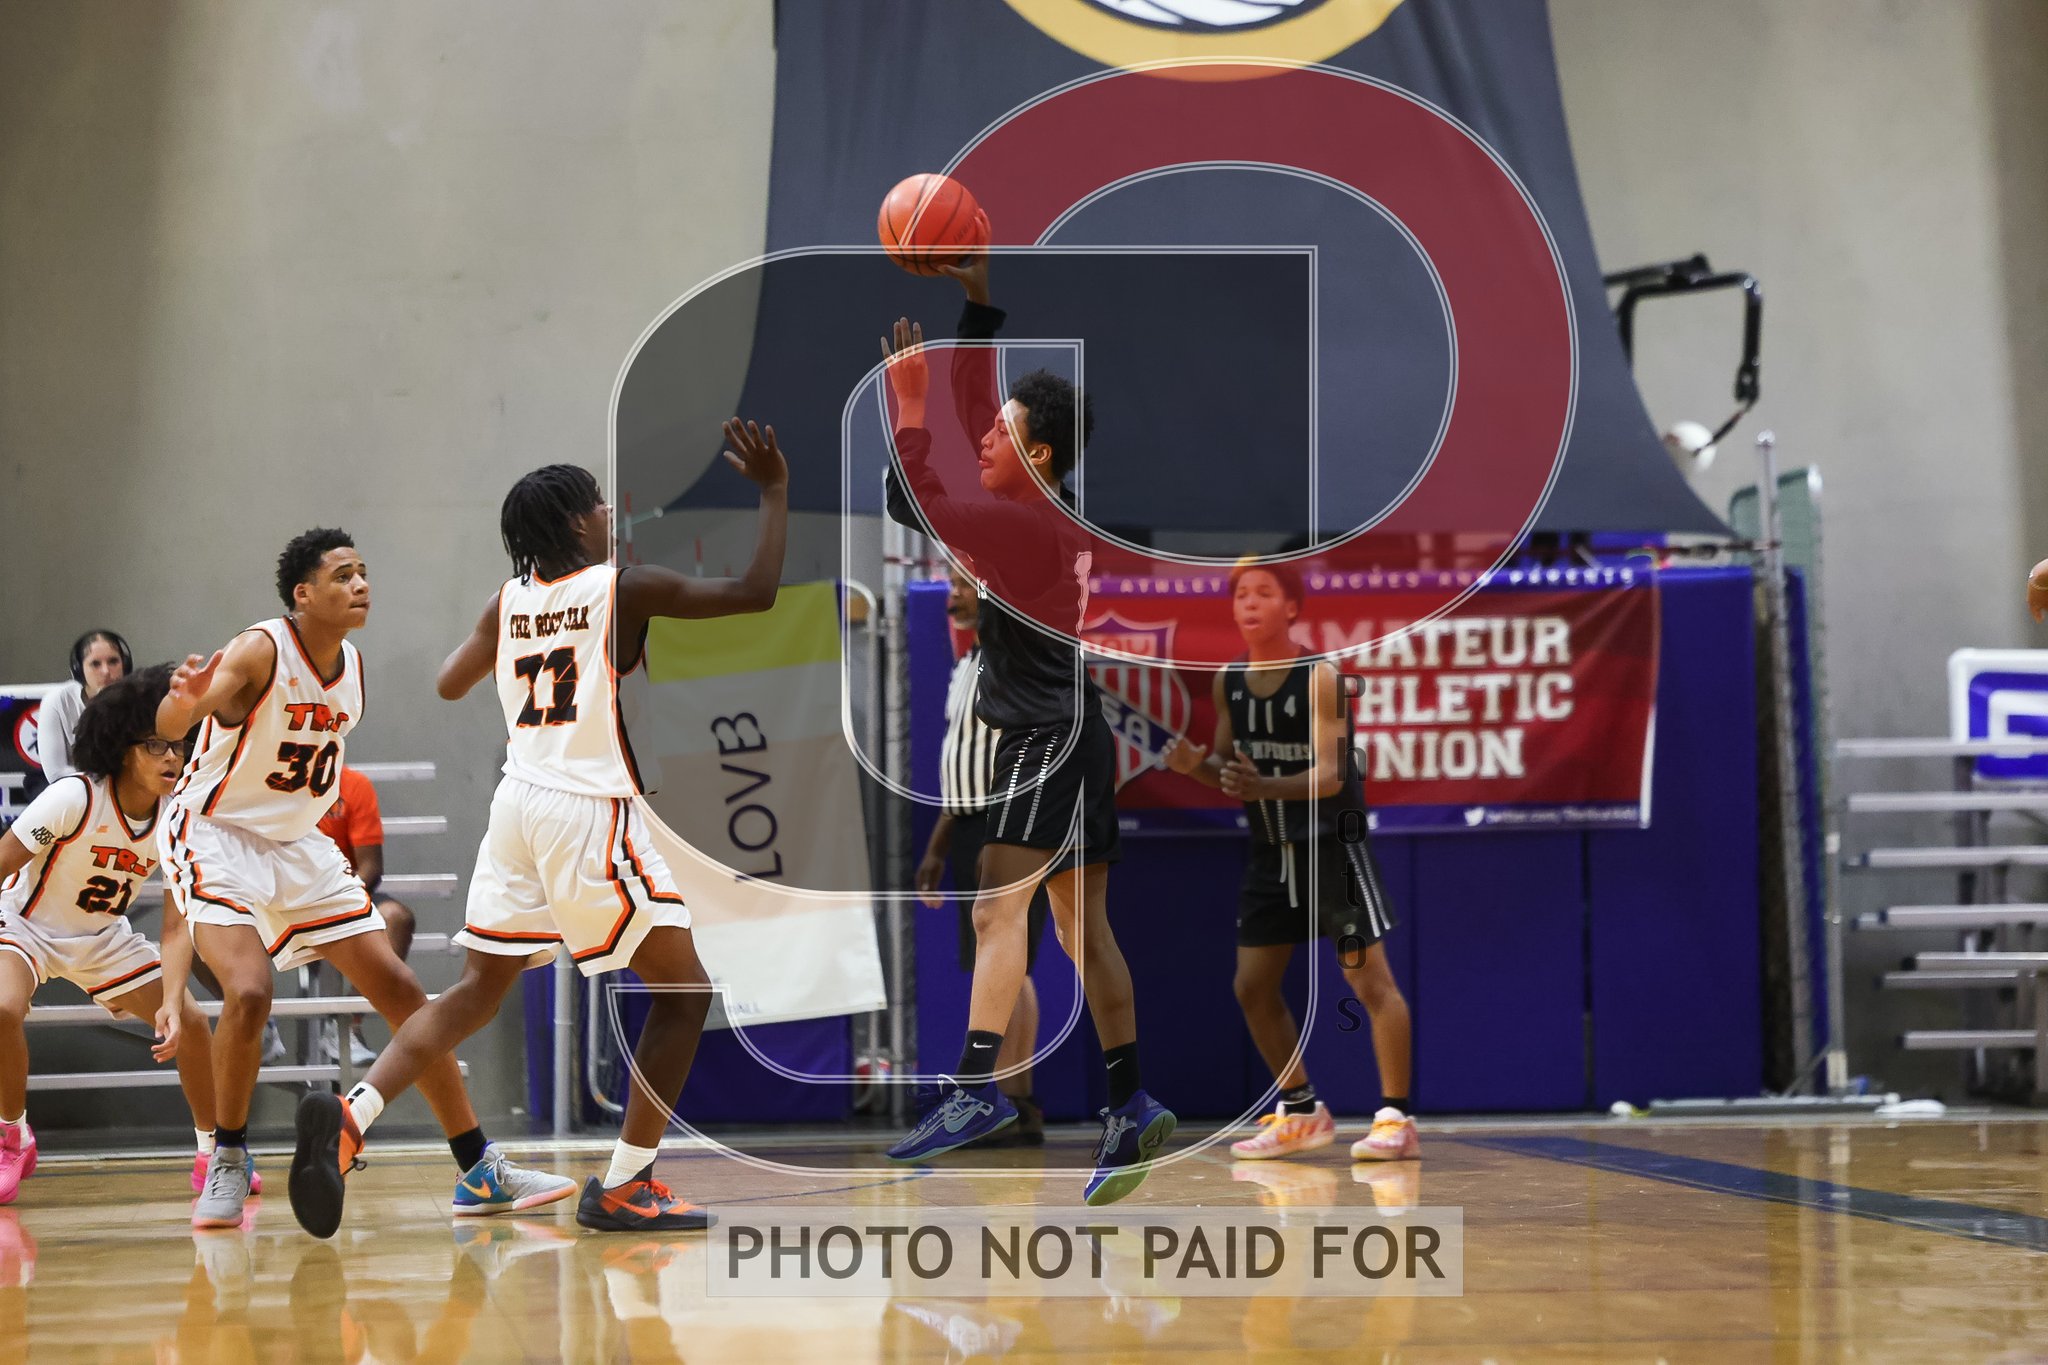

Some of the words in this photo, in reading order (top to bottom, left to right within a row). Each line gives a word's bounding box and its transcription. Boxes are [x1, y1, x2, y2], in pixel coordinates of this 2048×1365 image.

[1347, 672, 1575, 724] HLETIC
[264, 740, 340, 799] 30
[711, 712, 784, 883] LOVB
[75, 874, 134, 917] 21
